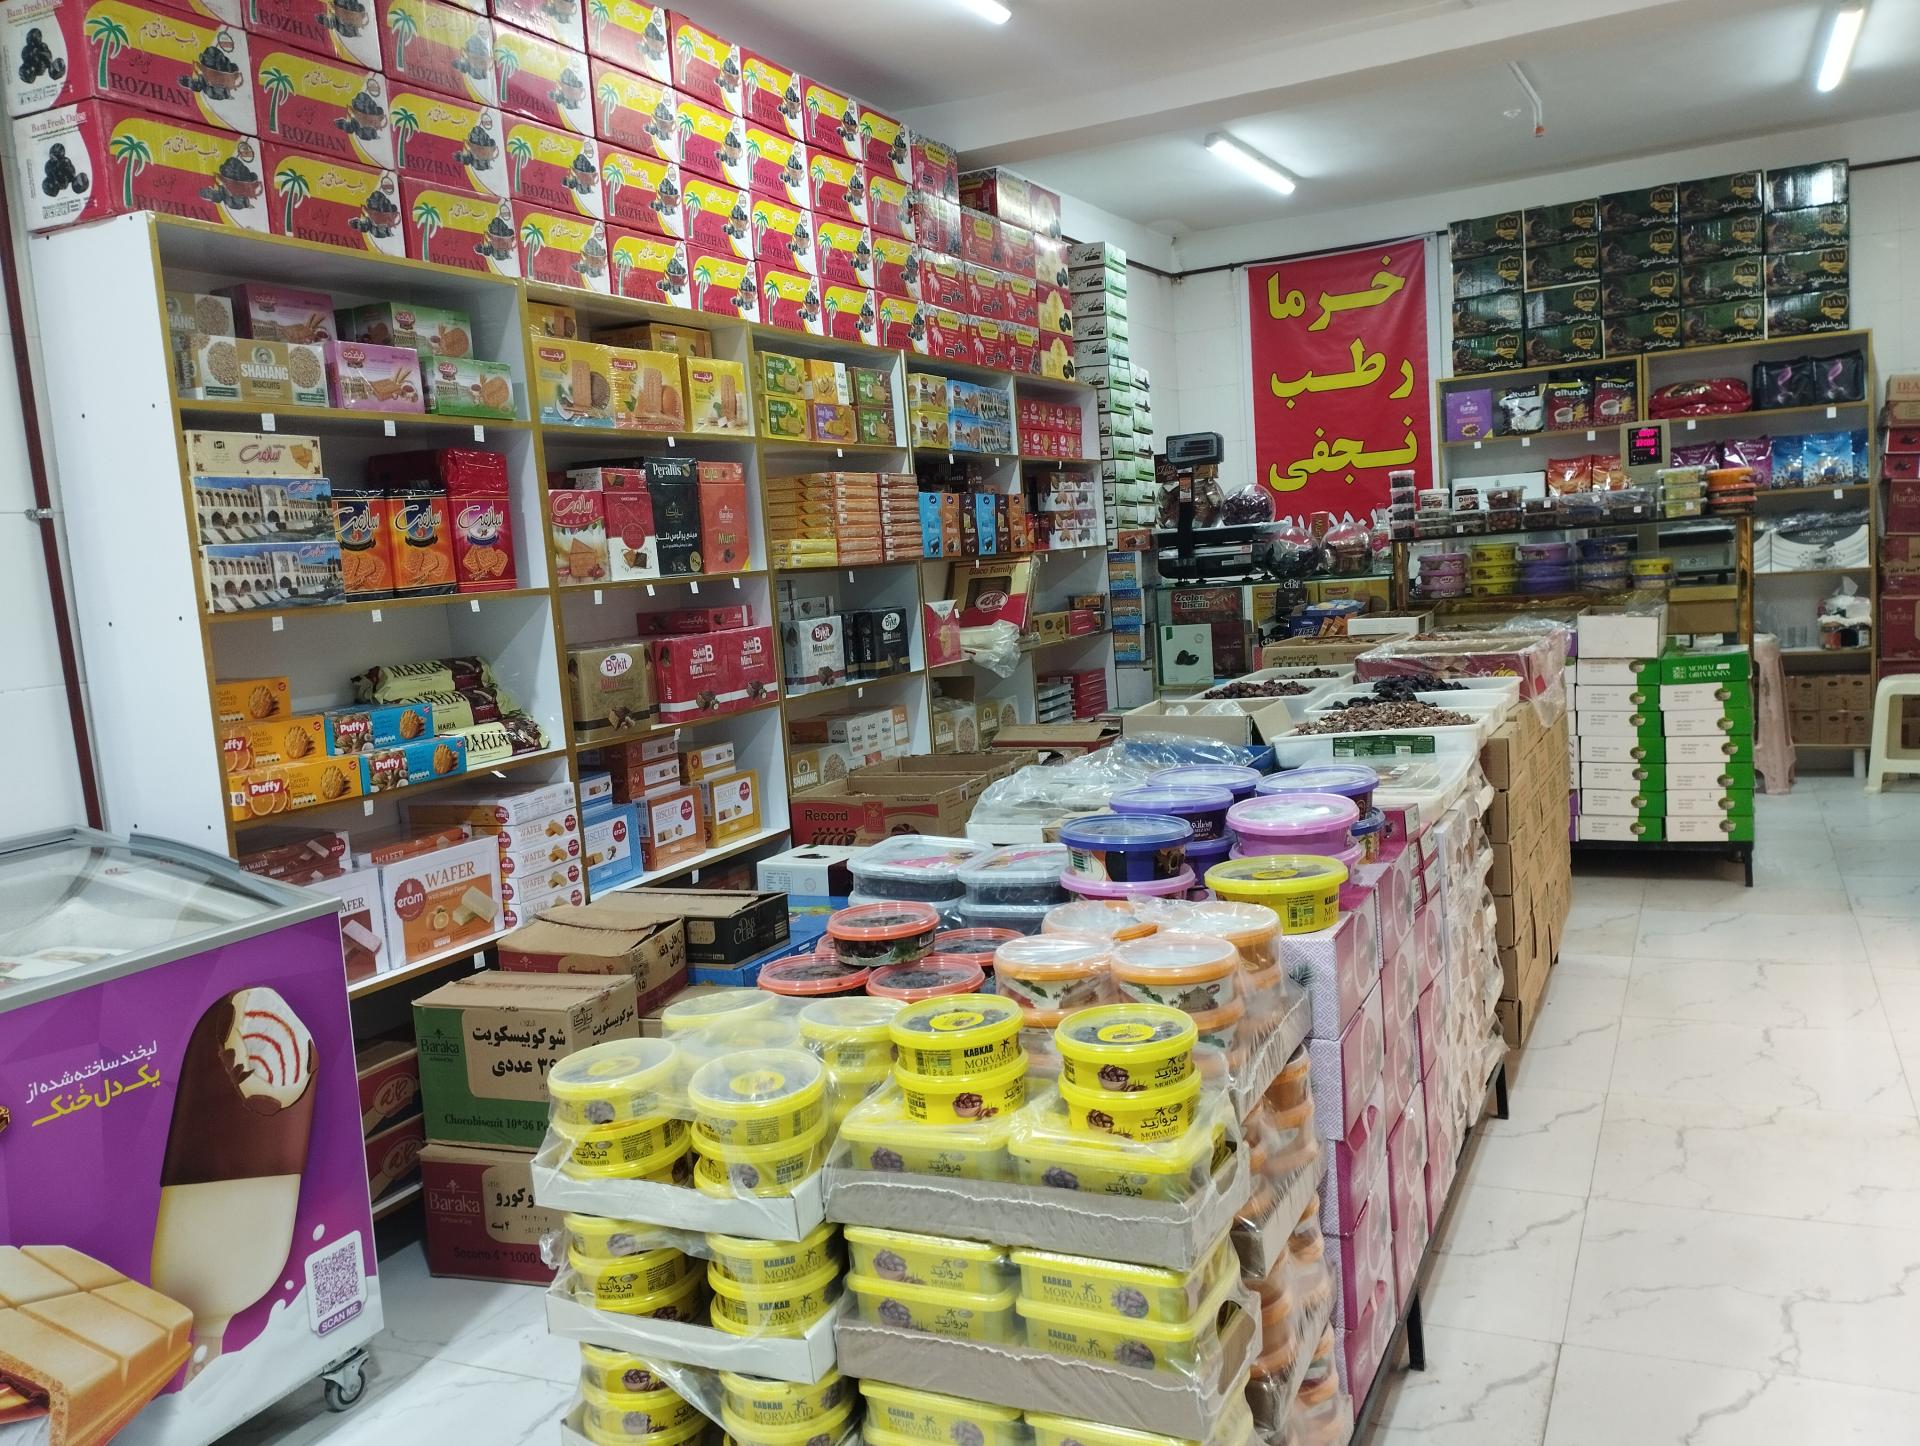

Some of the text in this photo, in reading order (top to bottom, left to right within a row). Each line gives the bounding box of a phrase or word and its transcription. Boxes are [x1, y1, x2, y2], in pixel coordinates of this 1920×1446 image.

[259, 10, 325, 42] ROZHAN
[111, 73, 191, 107] ROZHAN
[282, 124, 346, 153] ROZHAN
[407, 154, 462, 177] ROZHAN
[686, 151, 721, 172] ROZHAN
[522, 182, 570, 206] ROZHAN
[615, 204, 656, 224] ROZHAN
[297, 226, 361, 249] ROZHAN
[695, 230, 729, 249] ROZHAN
[432, 253, 485, 271] ROZHAN
[1267, 255, 1407, 332] خرما
[241, 364, 289, 380] SHAHANG
[1270, 337, 1414, 410] رطب
[1268, 415, 1418, 492] نجفی
[1182, 601, 1210, 610] Biscuit
[389, 661, 448, 679] MARIA
[606, 656, 628, 675] Bykit
[340, 721, 366, 734] Puffy
[375, 758, 400, 771] Puffy
[251, 781, 281, 795] Puffy
[805, 809, 848, 822] Record
[522, 849, 546, 863] WAFER
[425, 861, 475, 888] WAFER
[339, 896, 364, 914] AFER
[397, 892, 423, 908] eram
[119, 1040, 157, 1066] لبخند
[420, 1037, 460, 1055] Baraka
[964, 1044, 994, 1058] KABKAB
[492, 1058, 532, 1077] عددی
[965, 1047, 1014, 1069] MORVARID
[25, 1083, 38, 1104] از
[93, 1080, 123, 1108] دل
[1141, 1115, 1178, 1129] مروارید
[1105, 1184, 1143, 1197] مروارید
[429, 1192, 480, 1213] Baraka
[763, 1255, 796, 1268] KABKAB
[765, 1254, 821, 1280] MORVARID
[1042, 1275, 1073, 1288] KABKAB
[1044, 1286, 1102, 1305] MORVARID
[758, 1299, 791, 1312] KABKAB
[760, 1299, 818, 1322] MORVARID
[321, 1301, 361, 1332] SCAN ME
[1048, 1328, 1077, 1342] KABKAB
[1049, 1339, 1106, 1359] MORVARID
[753, 1399, 783, 1411] KABKAB
[754, 1406, 814, 1422] MORVARID
[888, 1407, 915, 1420] KABKAB
[889, 1417, 942, 1437] MORVARID
